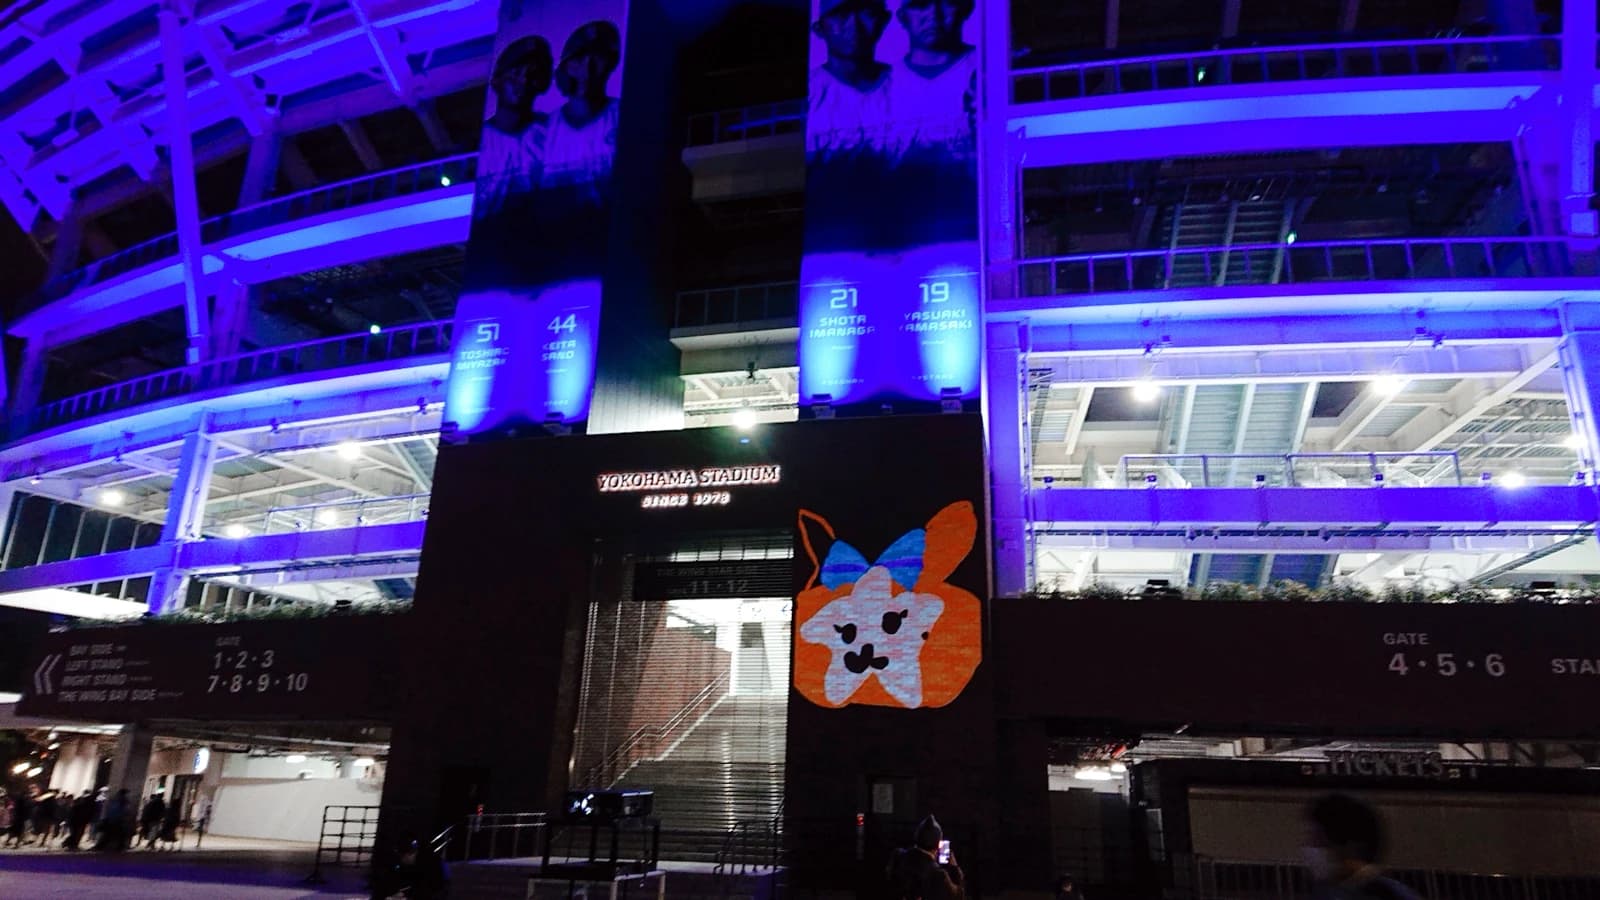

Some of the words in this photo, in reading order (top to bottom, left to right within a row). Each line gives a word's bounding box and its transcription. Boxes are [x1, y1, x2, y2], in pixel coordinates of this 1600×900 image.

[830, 288, 858, 309] 21
[918, 281, 950, 303] 19
[547, 313, 577, 335] 44
[819, 315, 867, 327] SHOTA
[904, 309, 966, 321] YASUAKI
[475, 323, 500, 343] 51
[597, 470, 699, 492] YOKOHAMA
[700, 465, 781, 487] STADIUM
[641, 493, 689, 508] SINCE
[693, 491, 731, 506] 1978
[1383, 632, 1429, 645] GATE
[1324, 750, 1444, 776] TICKETS
